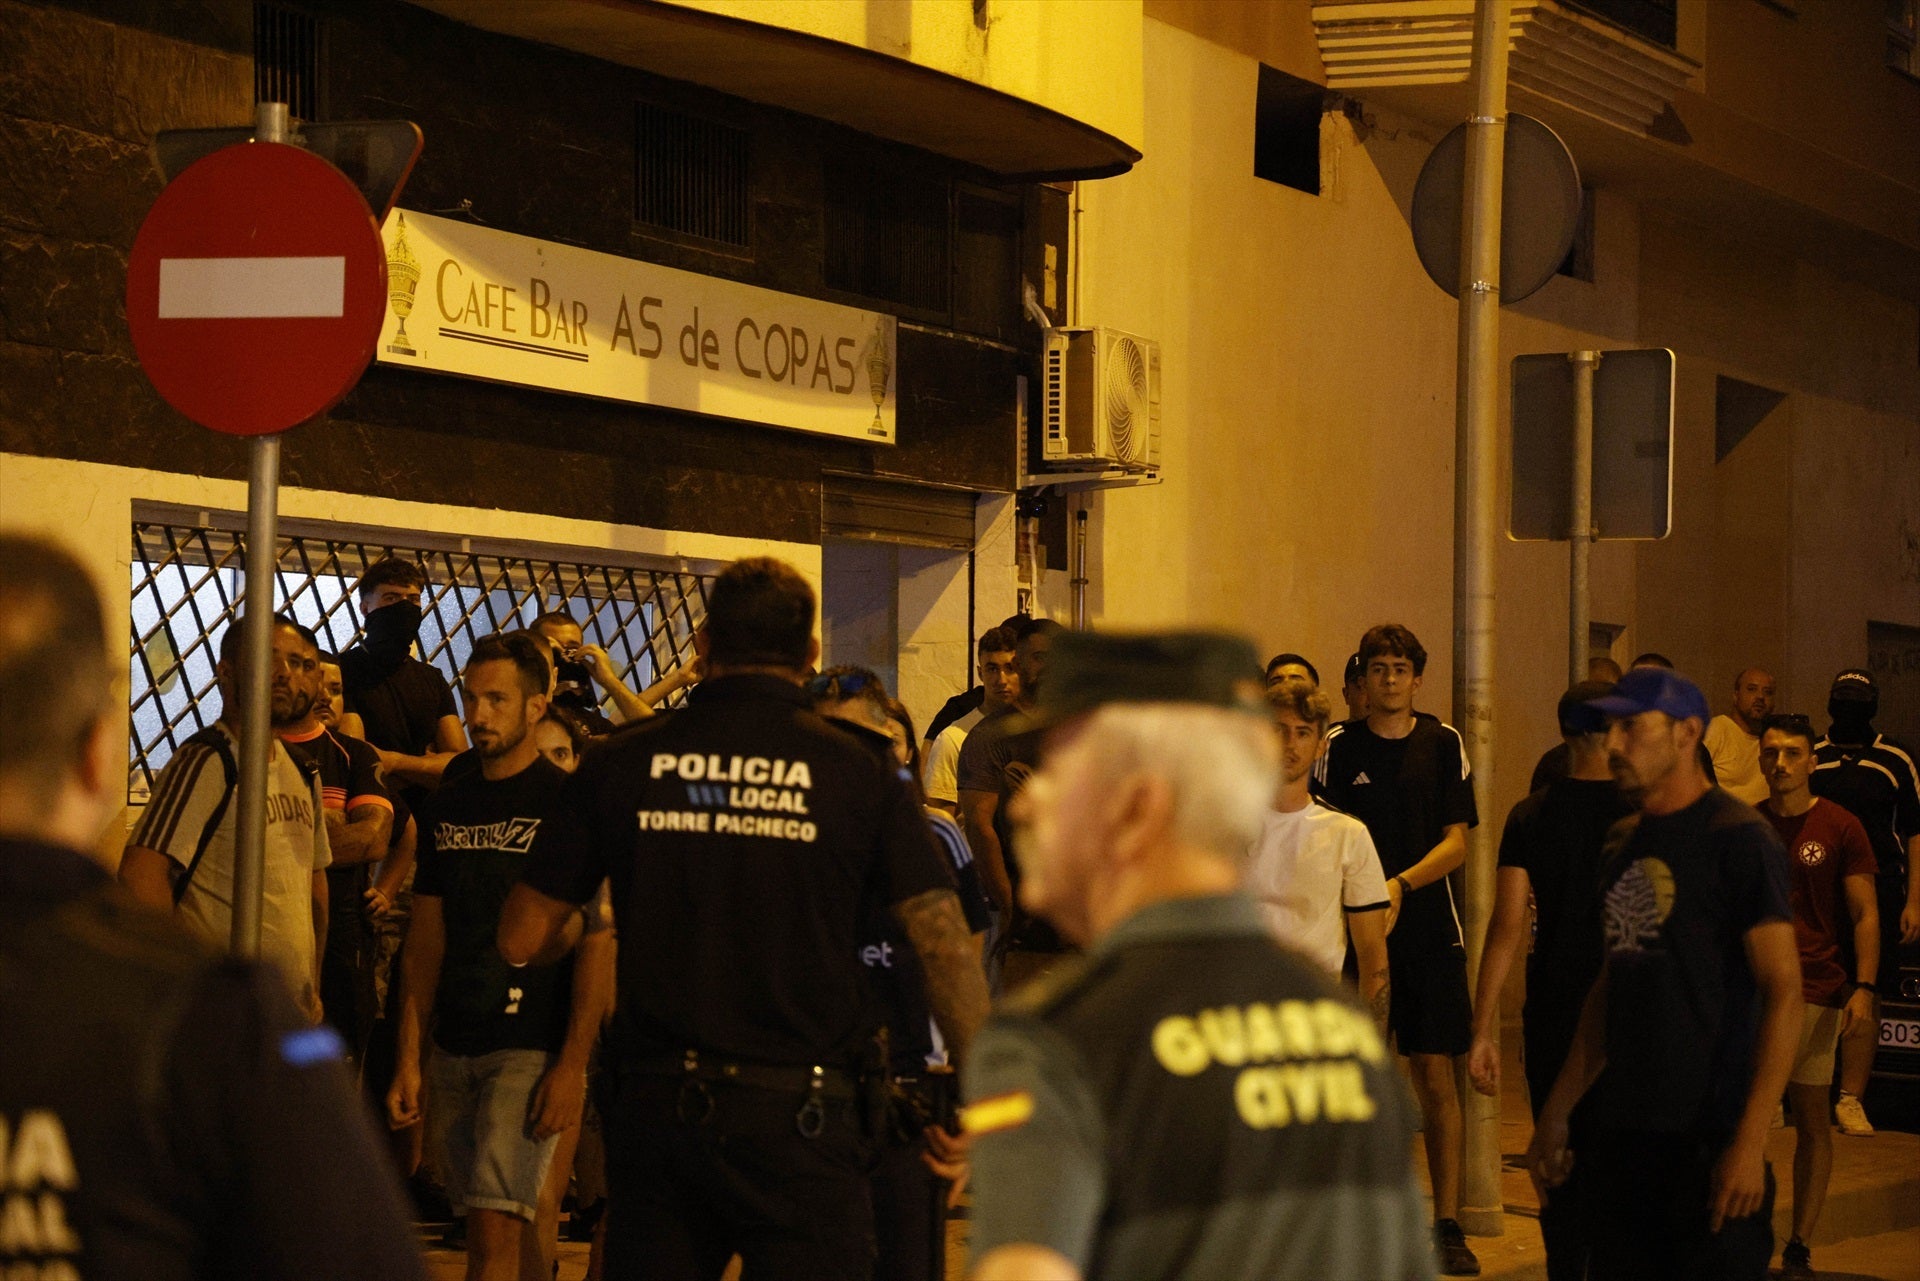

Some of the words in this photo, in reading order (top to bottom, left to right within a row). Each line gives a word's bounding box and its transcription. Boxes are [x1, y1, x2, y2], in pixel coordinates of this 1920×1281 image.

[436, 259, 516, 333] CAFE
[529, 278, 588, 347] BAR
[610, 294, 663, 359] AS
[679, 307, 720, 370] de
[735, 317, 856, 394] COPAS
[650, 753, 812, 789] POLICIA
[266, 793, 313, 830] DIDAS
[729, 787, 808, 814] LOCAL
[637, 810, 710, 832] TORRE
[714, 813, 817, 843] PACHECO
[861, 941, 893, 968] et
[1880, 1022, 1920, 1044] 603
